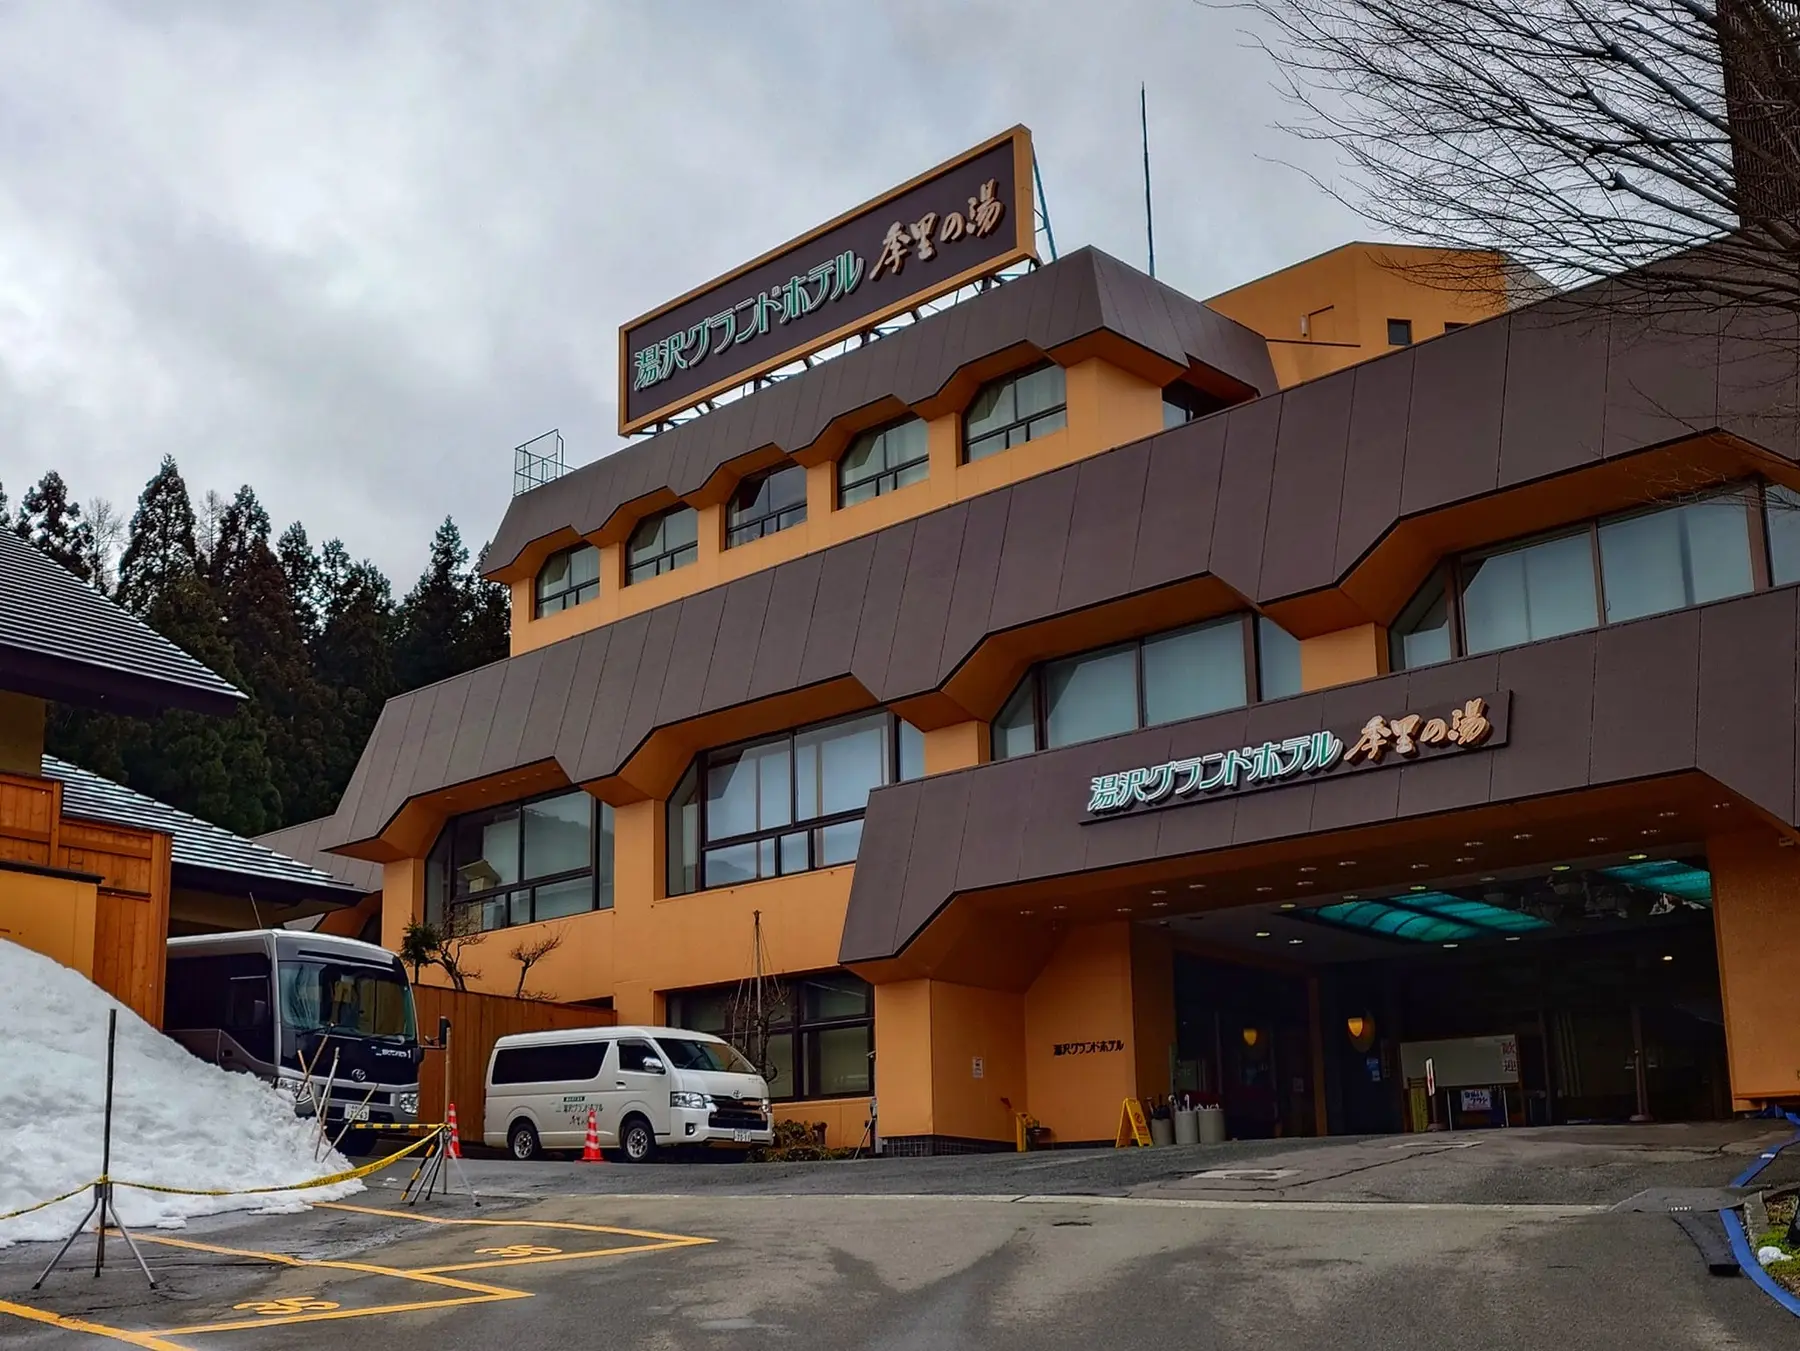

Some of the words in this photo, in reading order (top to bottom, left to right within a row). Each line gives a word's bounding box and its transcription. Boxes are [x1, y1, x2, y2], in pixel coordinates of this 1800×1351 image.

[633, 249, 866, 391] 湯沢グランドホテル
[869, 178, 1005, 281] 季里の湯
[1087, 729, 1343, 815] 湯沢グランドホテル
[1344, 697, 1494, 764] 季里の湯
[232, 1296, 341, 1315] 35
